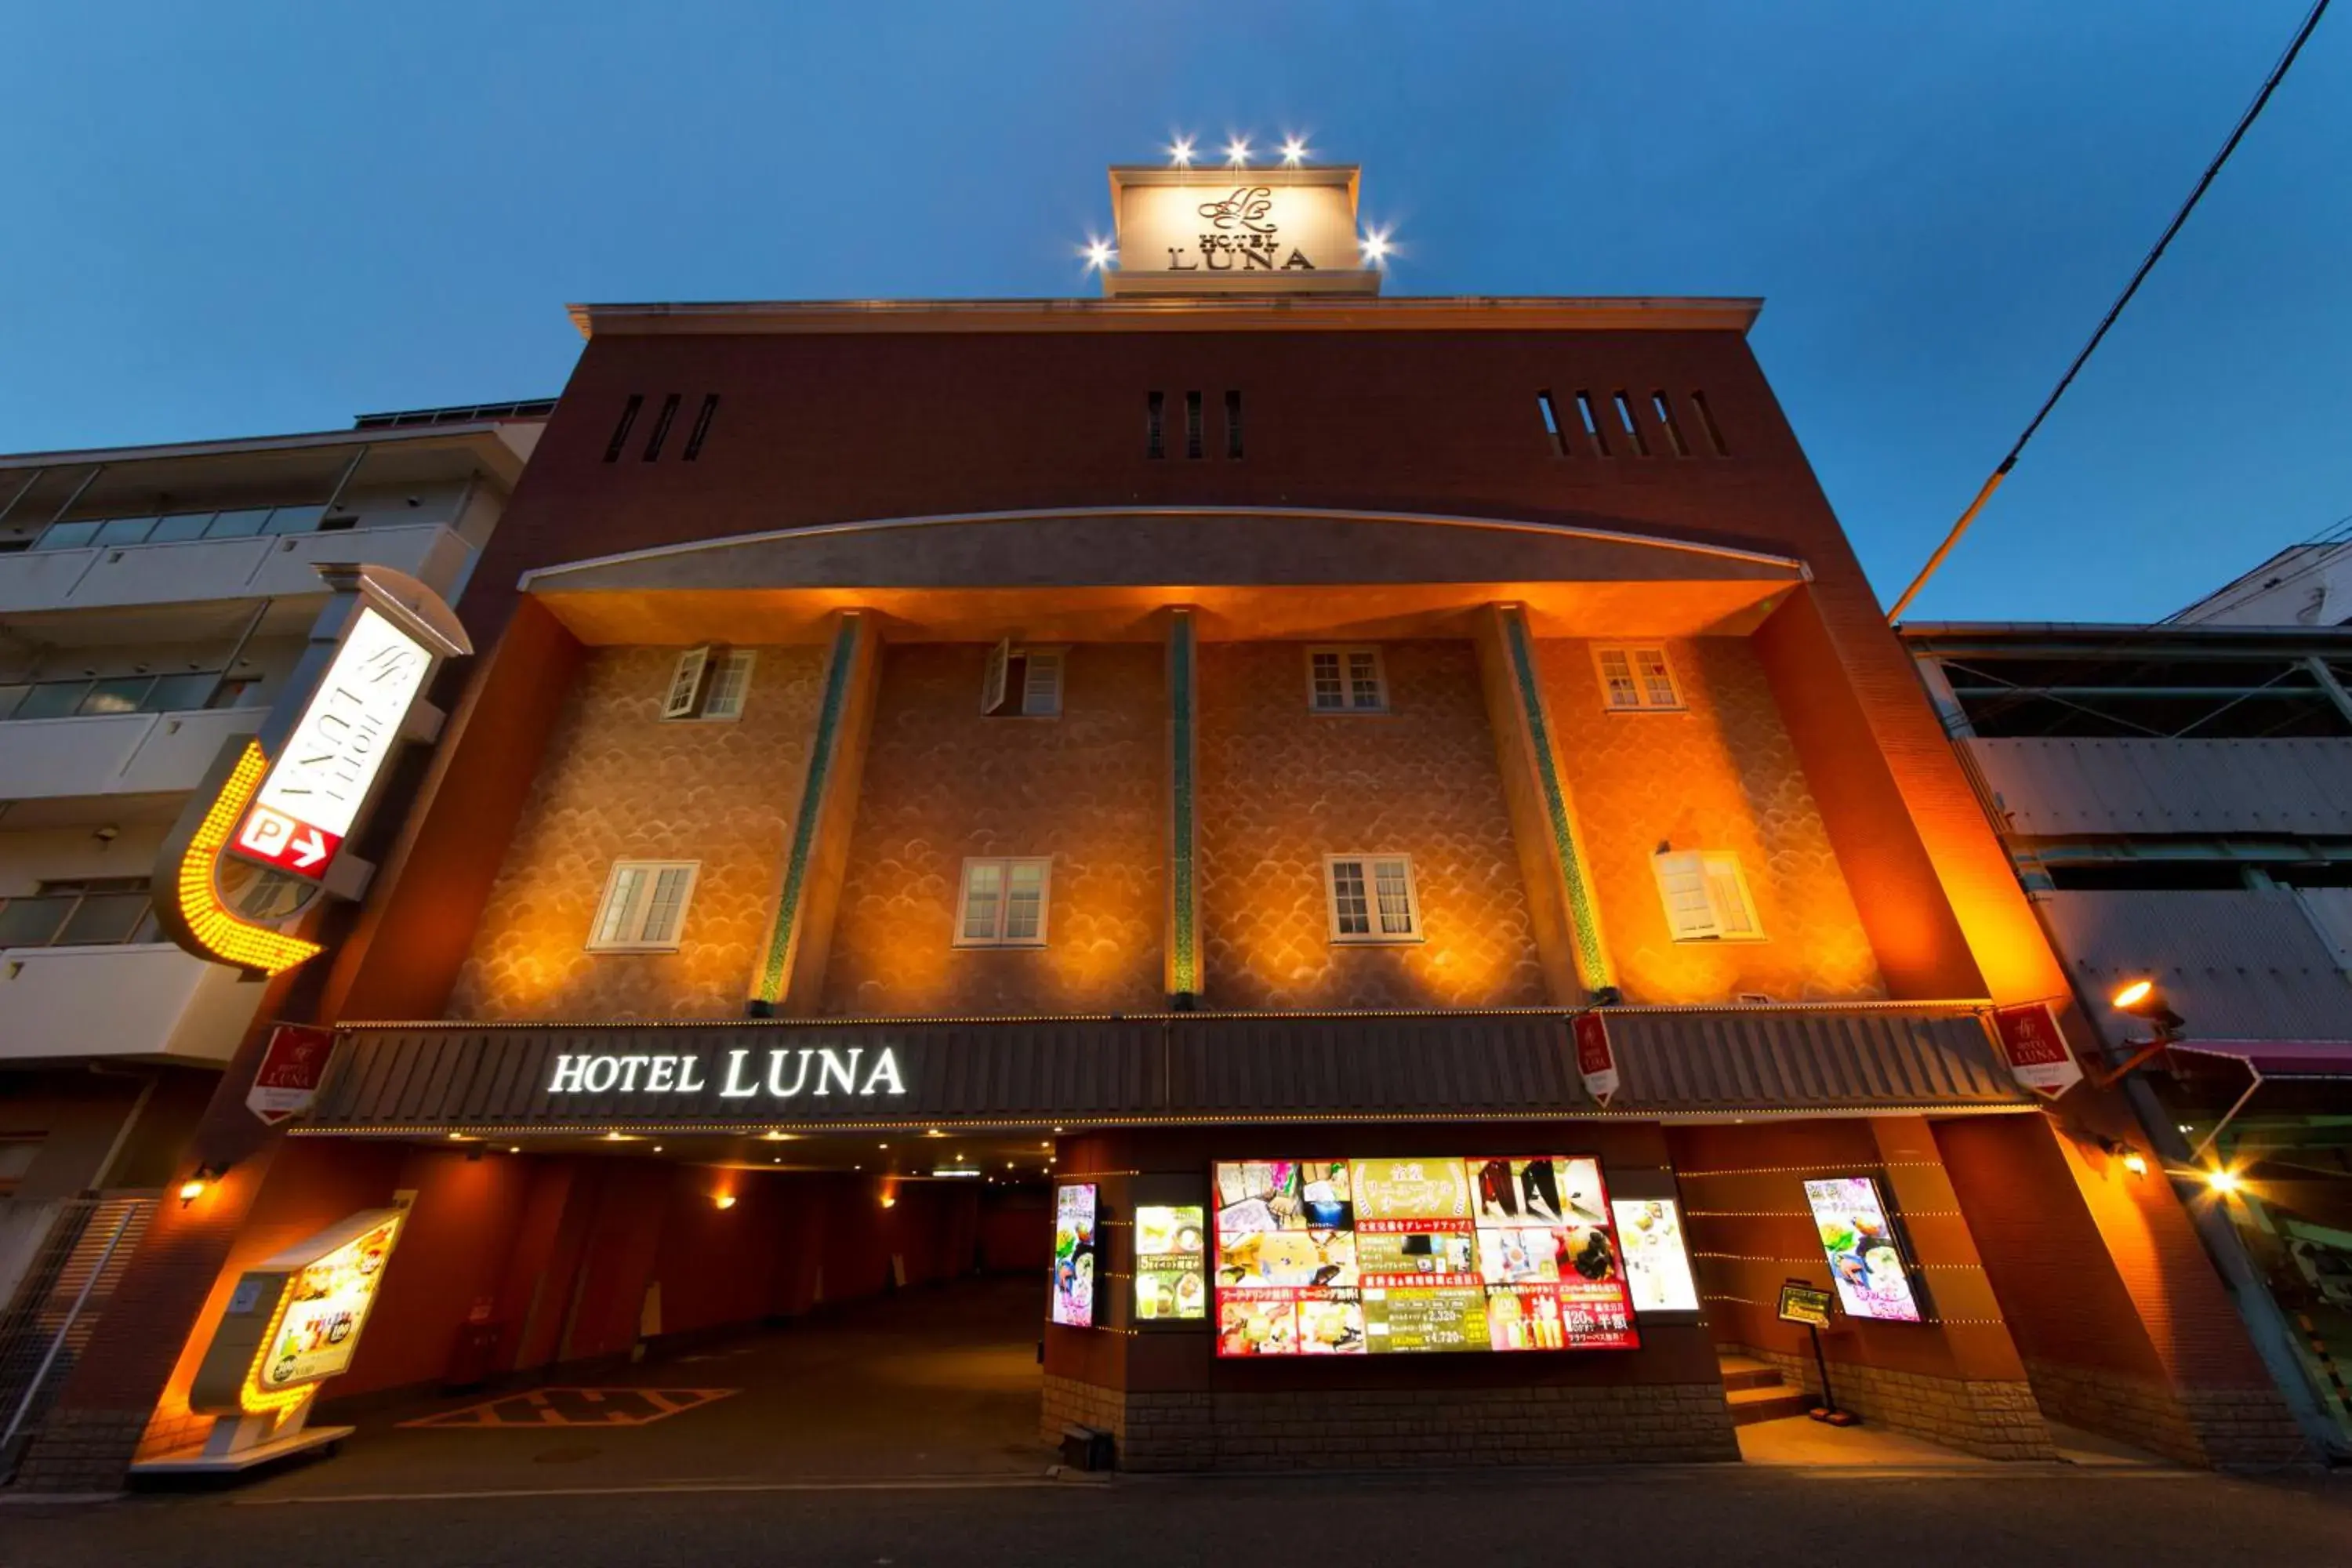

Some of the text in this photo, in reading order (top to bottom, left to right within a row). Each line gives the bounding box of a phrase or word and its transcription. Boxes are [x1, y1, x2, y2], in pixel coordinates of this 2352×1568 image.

[1199, 234, 1279, 248] HOTEL
[1168, 248, 1315, 270] LUNA
[255, 818, 284, 843] P
[2017, 1049, 2058, 1063] LUNA
[267, 1072, 309, 1087] LUNA
[547, 1054, 705, 1092] HOTEL
[720, 1046, 906, 1098] LUNA
